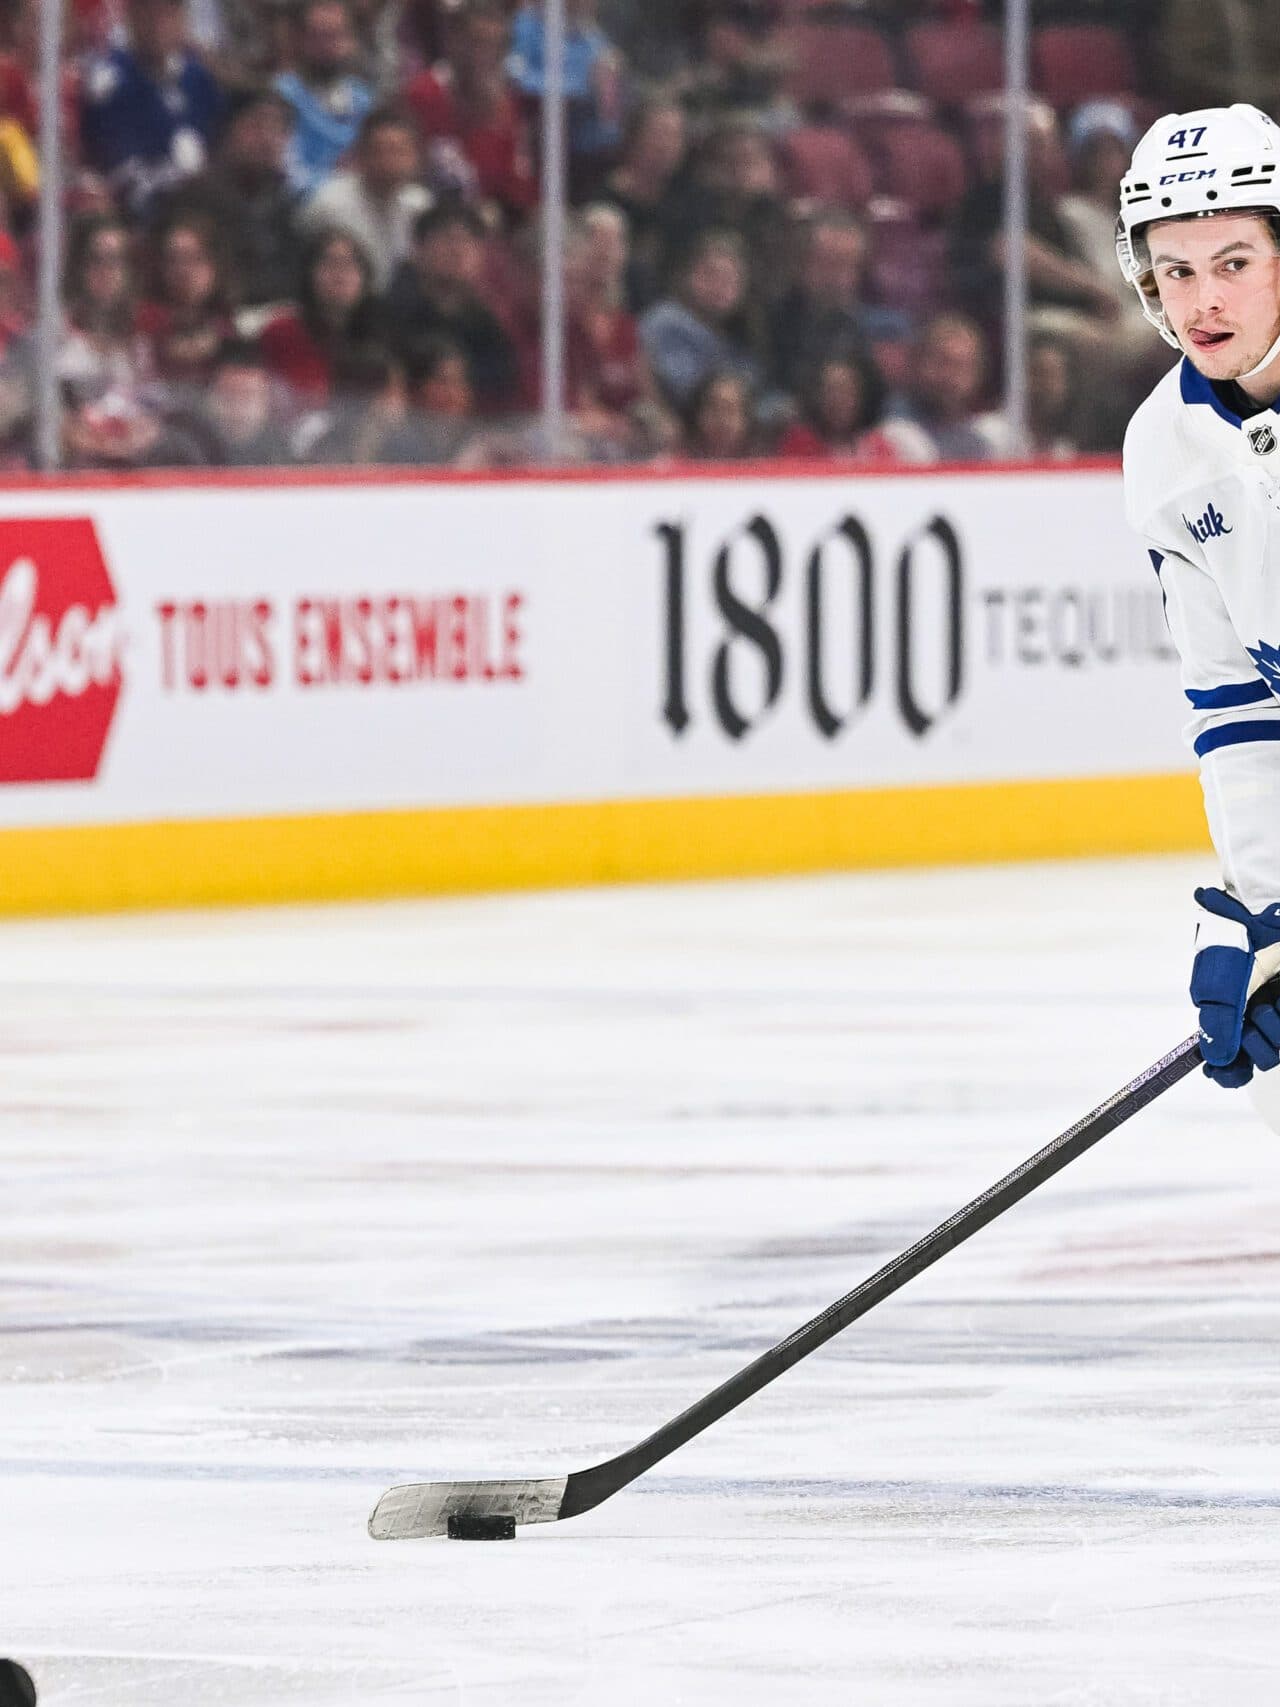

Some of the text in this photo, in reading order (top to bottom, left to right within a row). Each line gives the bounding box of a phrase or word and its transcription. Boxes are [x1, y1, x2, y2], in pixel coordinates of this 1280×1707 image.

[1167, 126, 1207, 149] 47
[1159, 168, 1217, 186] CCM
[157, 594, 524, 689] TOUS ENSEMBLE
[653, 513, 965, 744] 1800
